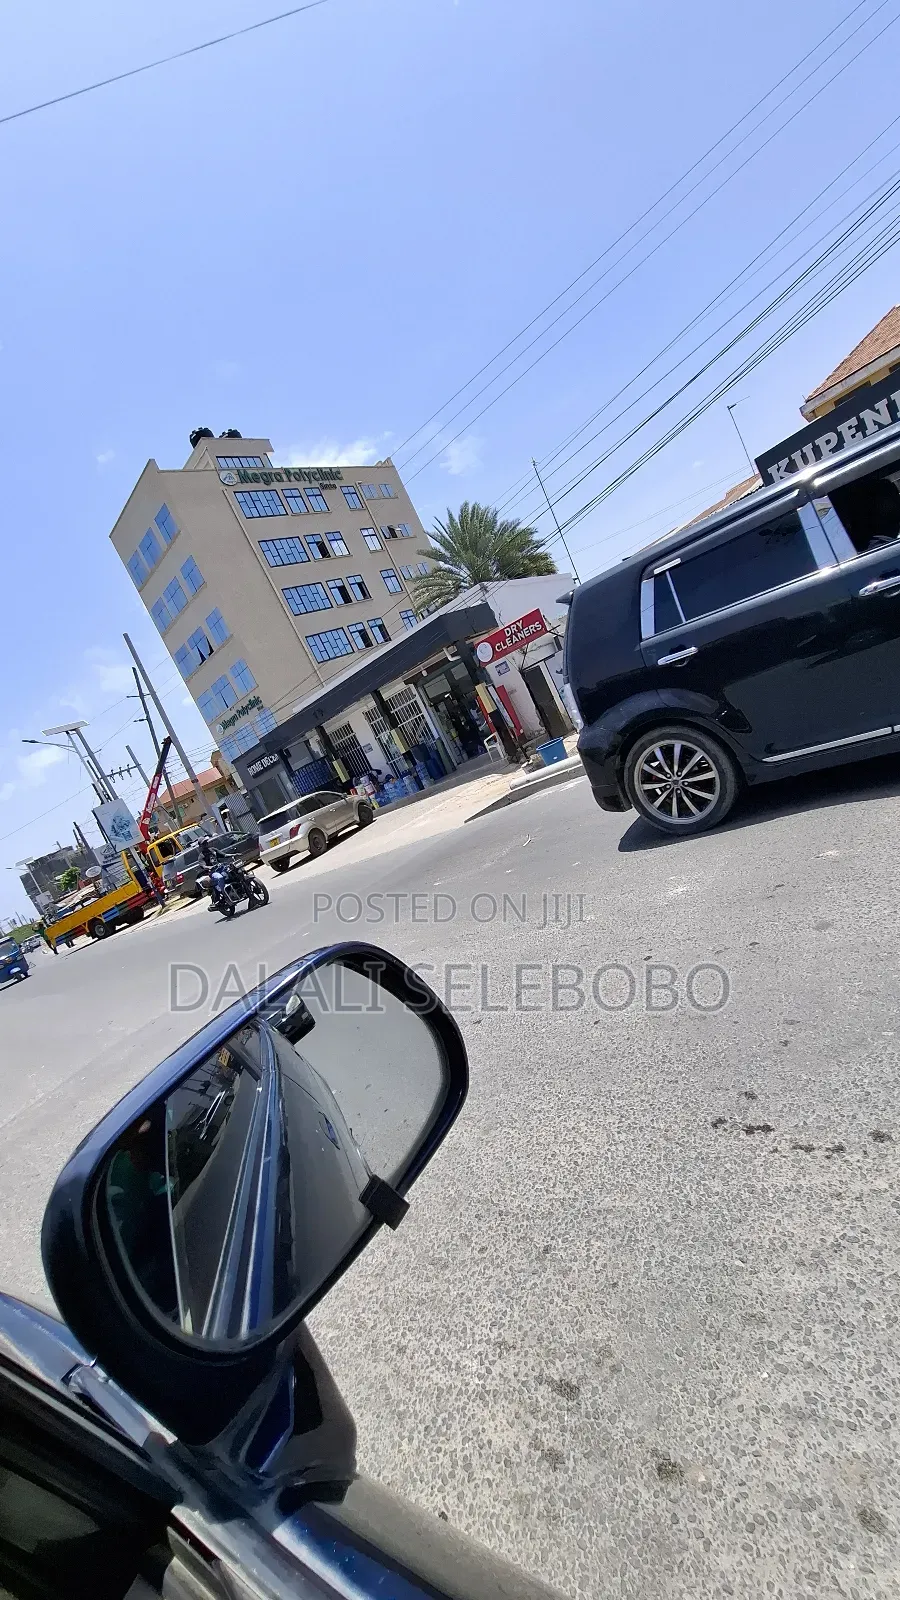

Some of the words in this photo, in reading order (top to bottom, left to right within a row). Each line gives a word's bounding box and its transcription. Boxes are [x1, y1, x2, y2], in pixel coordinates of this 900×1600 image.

[237, 468, 284, 485] Megra
[282, 467, 344, 484] Polyclinic
[495, 621, 542, 652] CLEANERS
[504, 620, 524, 638] DRY
[247, 760, 263, 776] HOME
